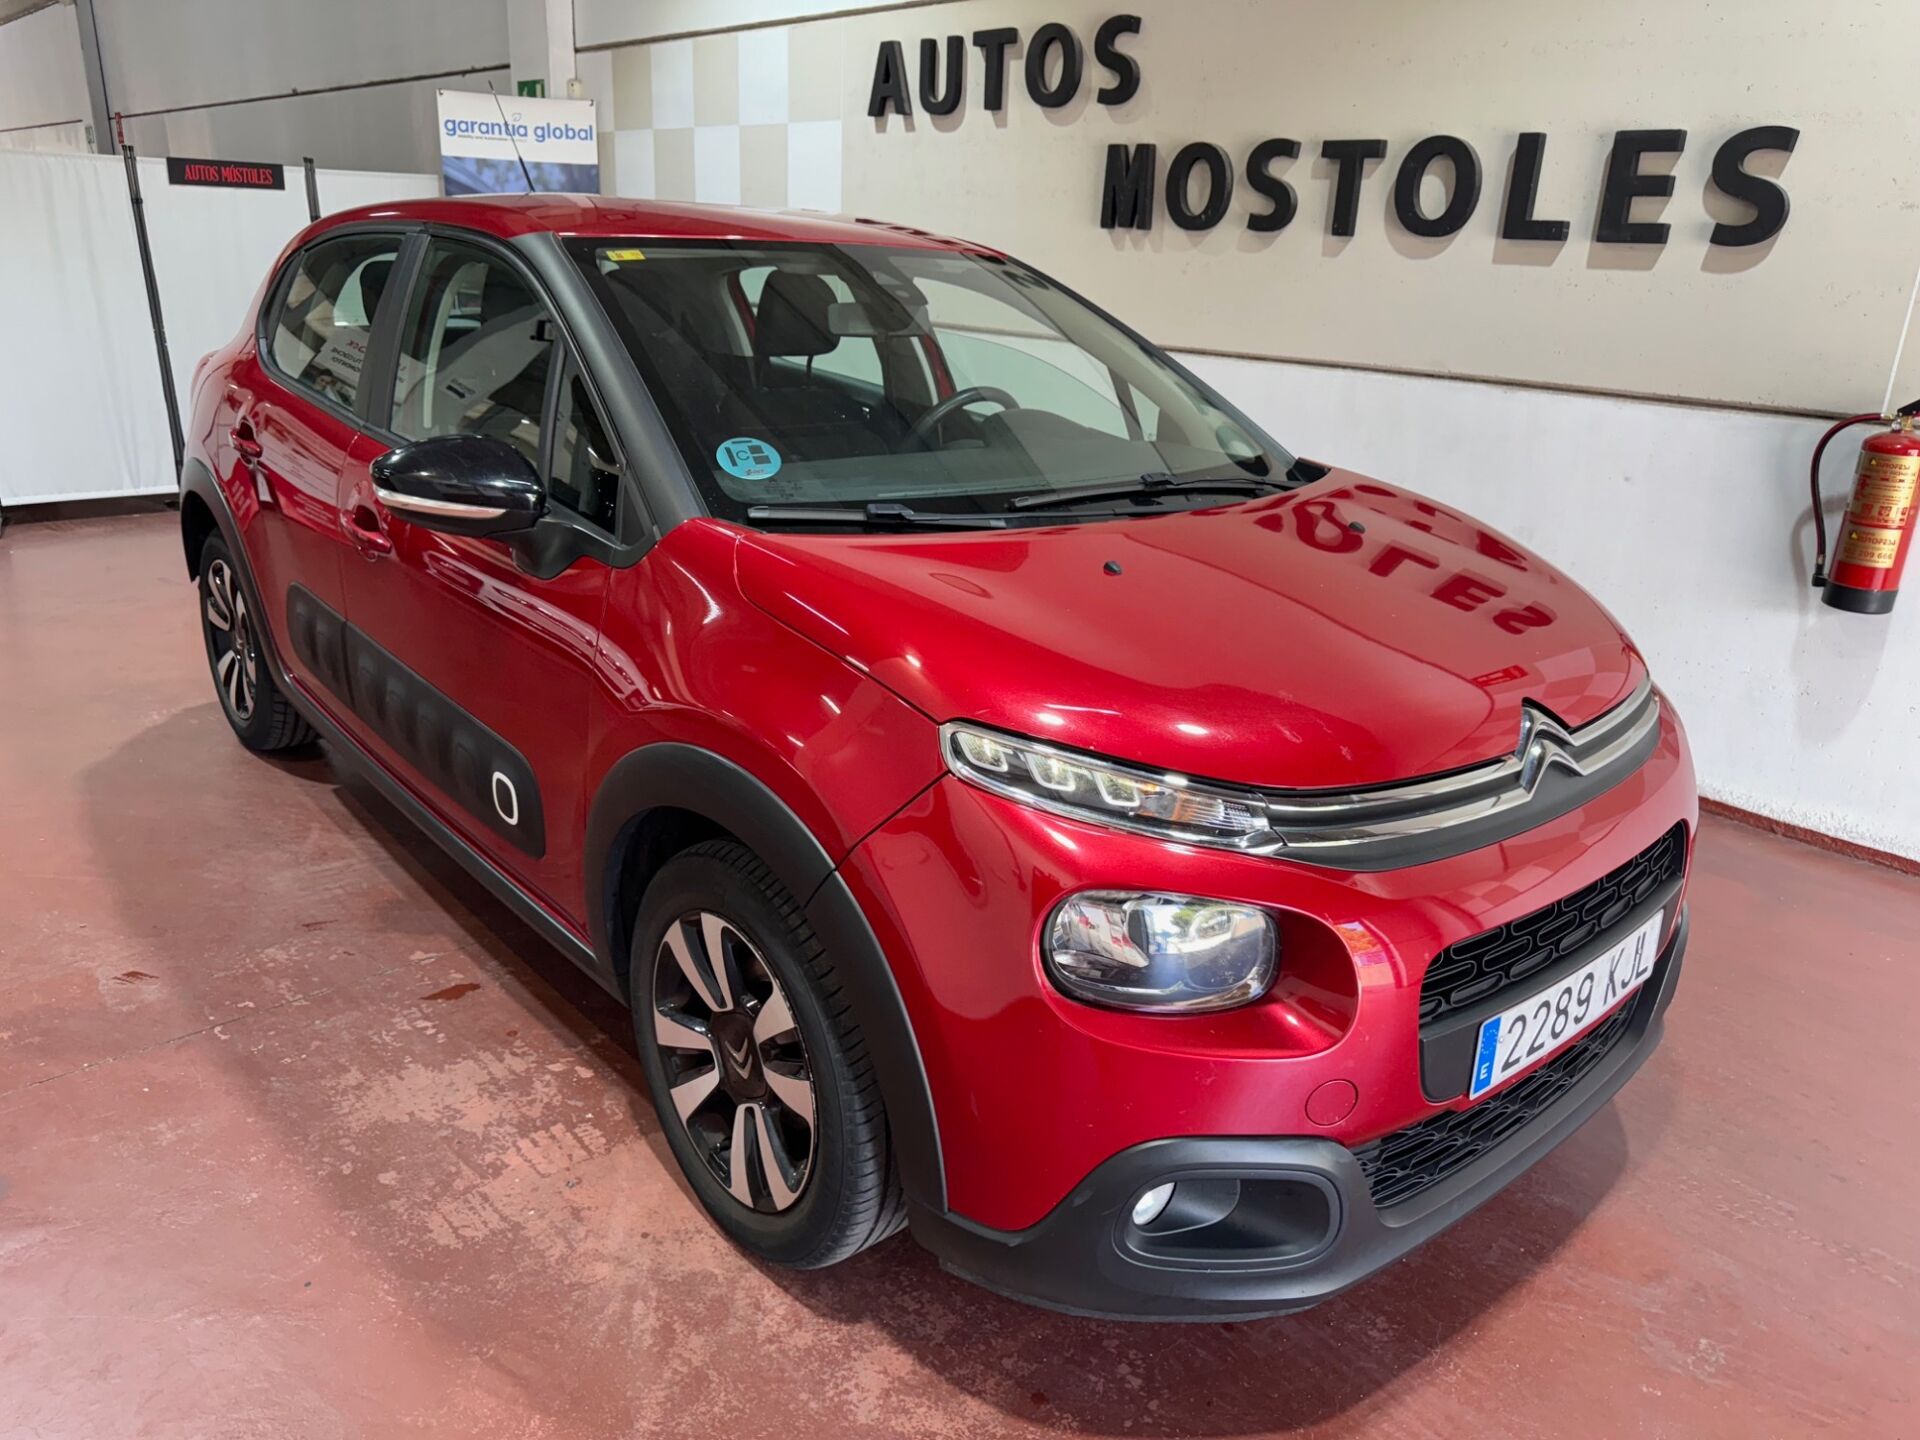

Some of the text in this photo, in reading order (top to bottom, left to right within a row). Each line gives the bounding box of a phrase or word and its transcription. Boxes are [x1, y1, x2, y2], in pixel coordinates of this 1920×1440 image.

[867, 14, 1142, 118] AUTOS
[534, 122, 594, 143] global
[184, 163, 273, 185] AUTOS MÓSTOLES
[1100, 125, 1800, 249] MOSTOLES
[1500, 931, 1649, 1074] 2289 KJL
[1479, 1062, 1490, 1079] E
